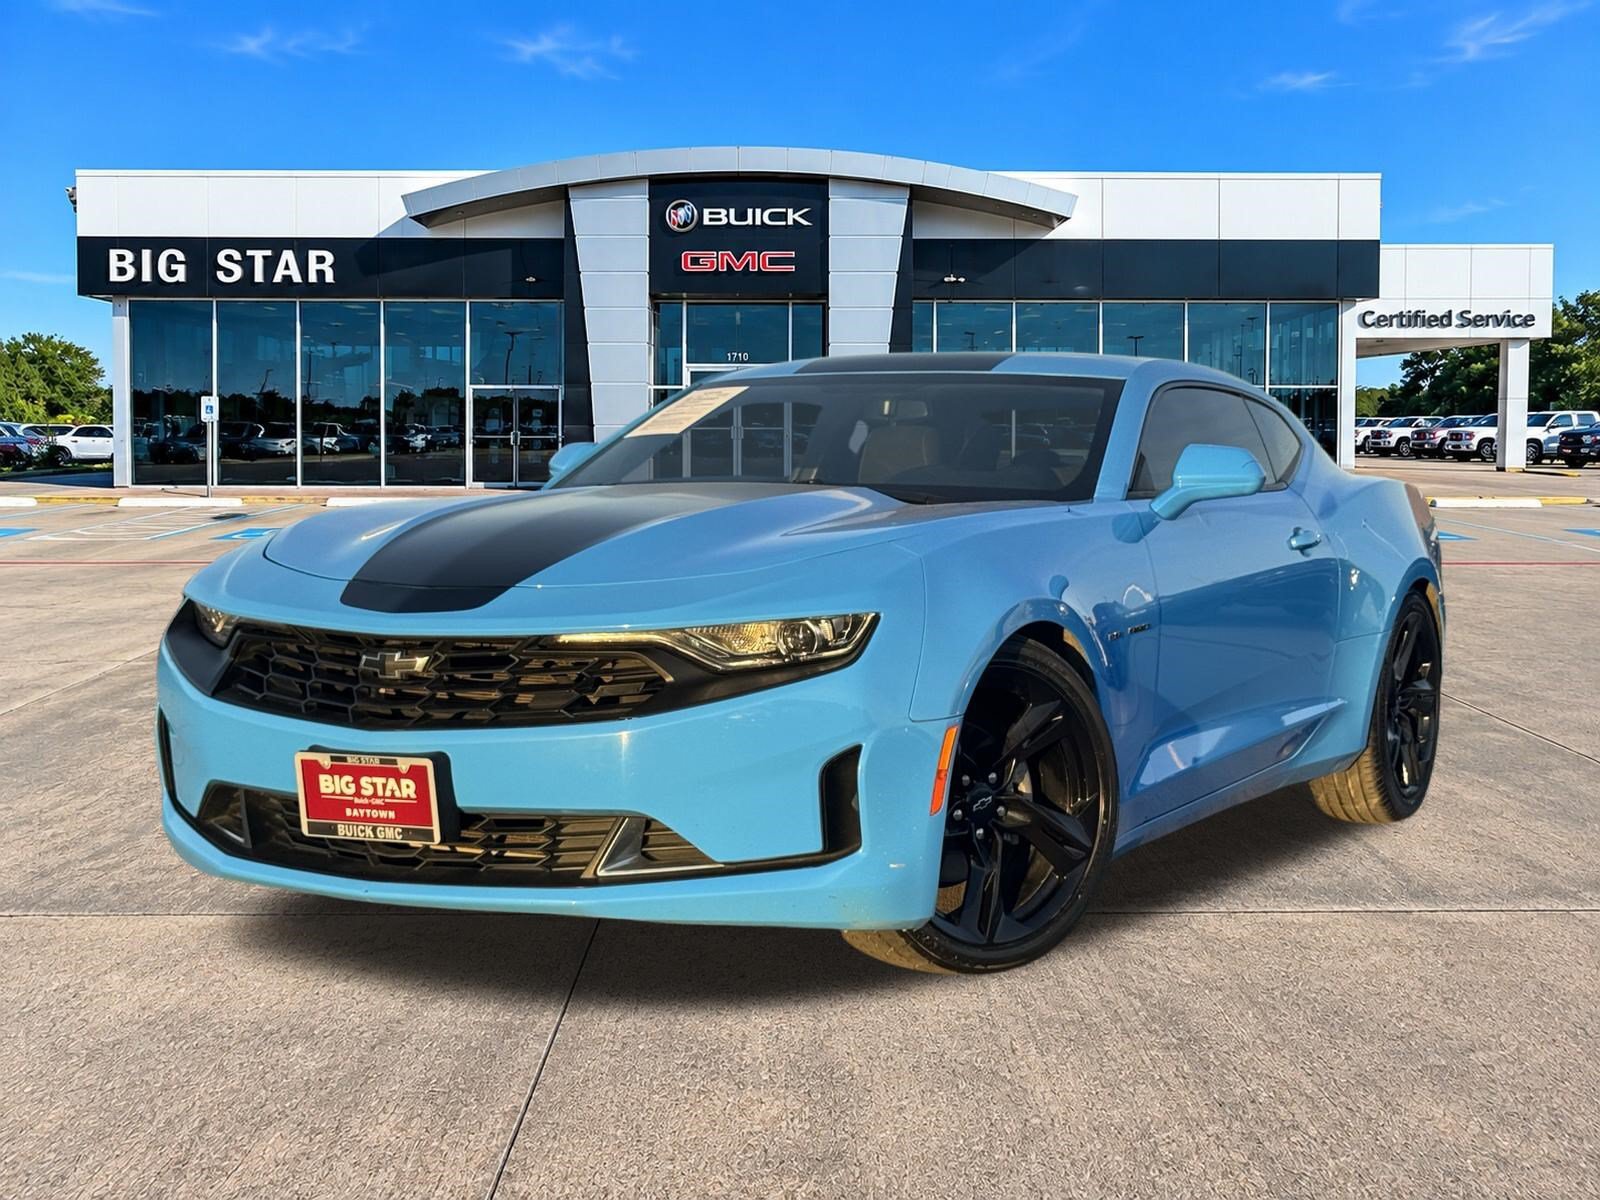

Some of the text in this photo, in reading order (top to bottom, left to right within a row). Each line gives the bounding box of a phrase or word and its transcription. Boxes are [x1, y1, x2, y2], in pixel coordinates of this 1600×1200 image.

[703, 208, 813, 226] BUICK
[109, 249, 336, 283] BIG STAR
[682, 251, 796, 272] GMC
[1360, 309, 1536, 328] Certified Service
[727, 352, 749, 361] 1710
[319, 774, 417, 799] BIG STAR
[345, 807, 396, 819] BAYTOWN
[337, 824, 403, 840] BUICK GMC
